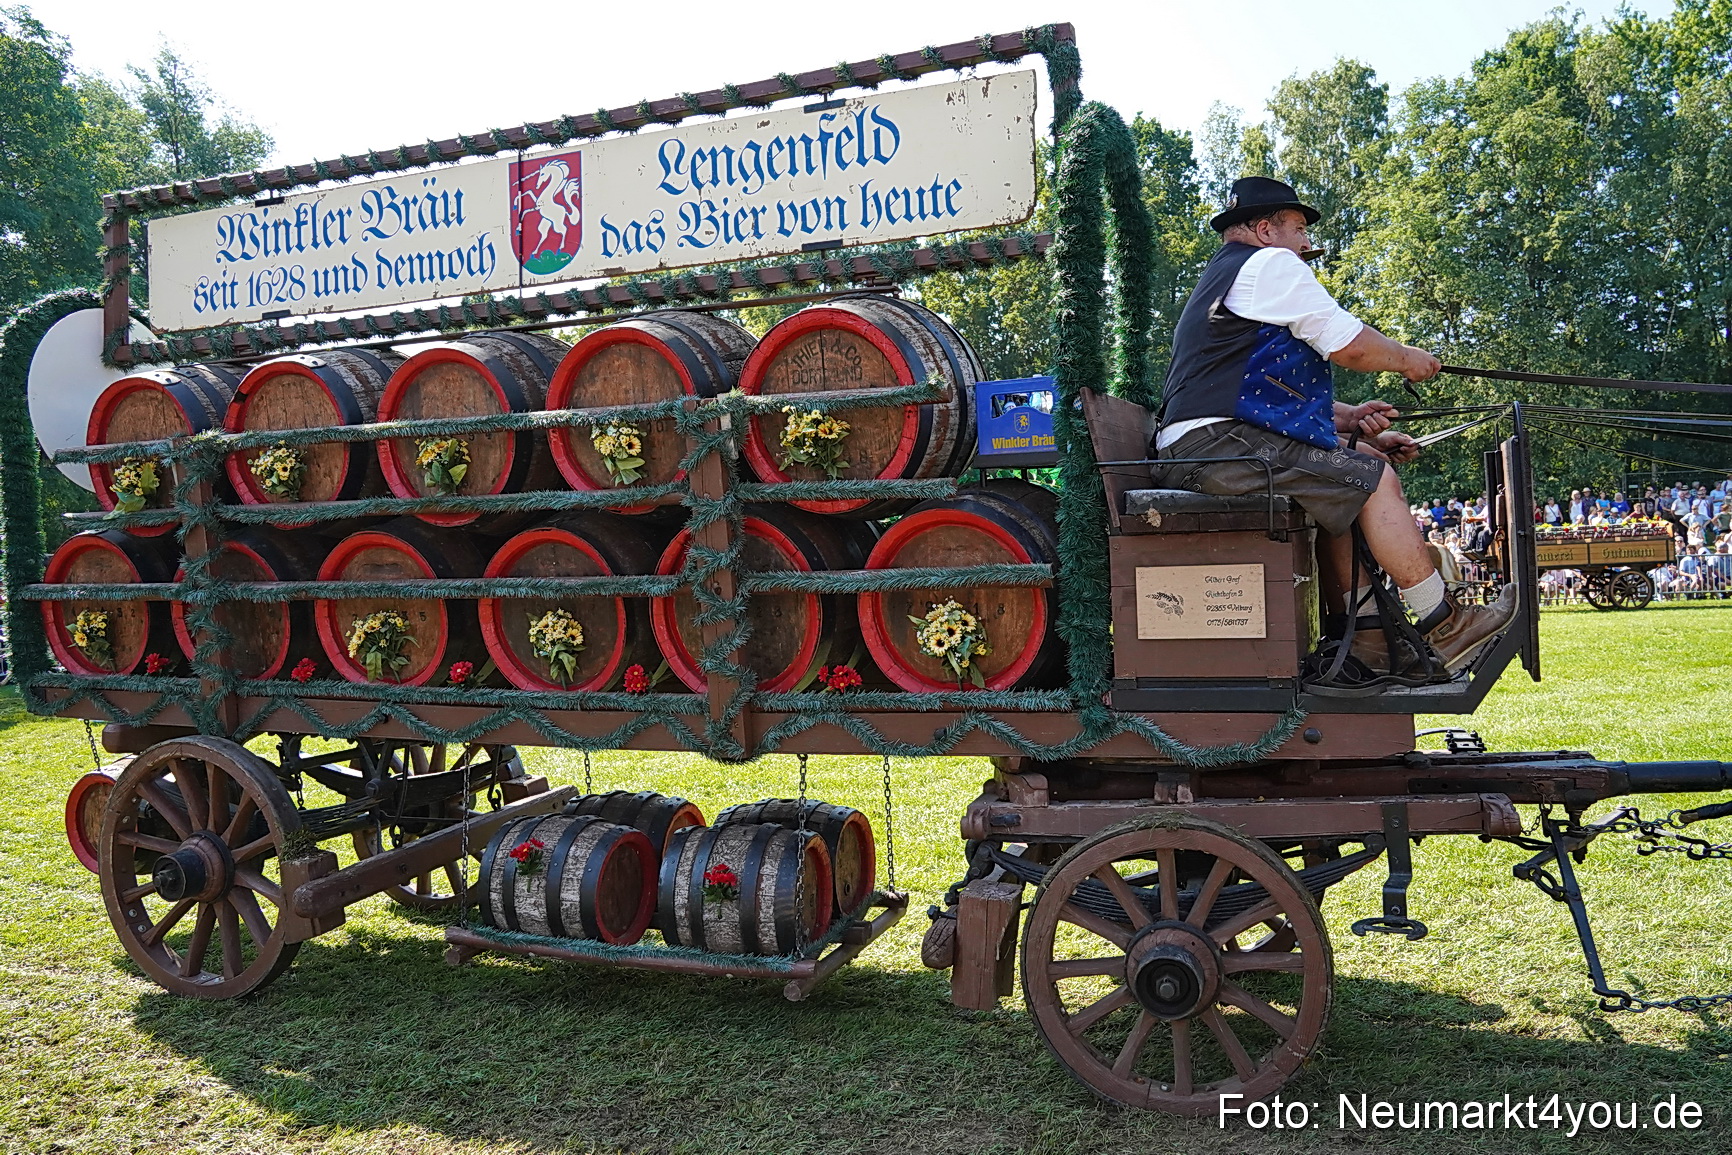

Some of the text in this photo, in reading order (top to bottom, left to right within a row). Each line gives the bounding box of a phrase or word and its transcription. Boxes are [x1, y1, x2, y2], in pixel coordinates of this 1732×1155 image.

[656, 104, 900, 195] Lengenfeld
[215, 177, 467, 263] Winkler Bräu
[600, 173, 963, 258] das Bier von heute
[193, 232, 495, 313] seit 1628 und dennoch
[992, 434, 1055, 449] Winkler Bräu
[1537, 549, 1574, 562] auerei
